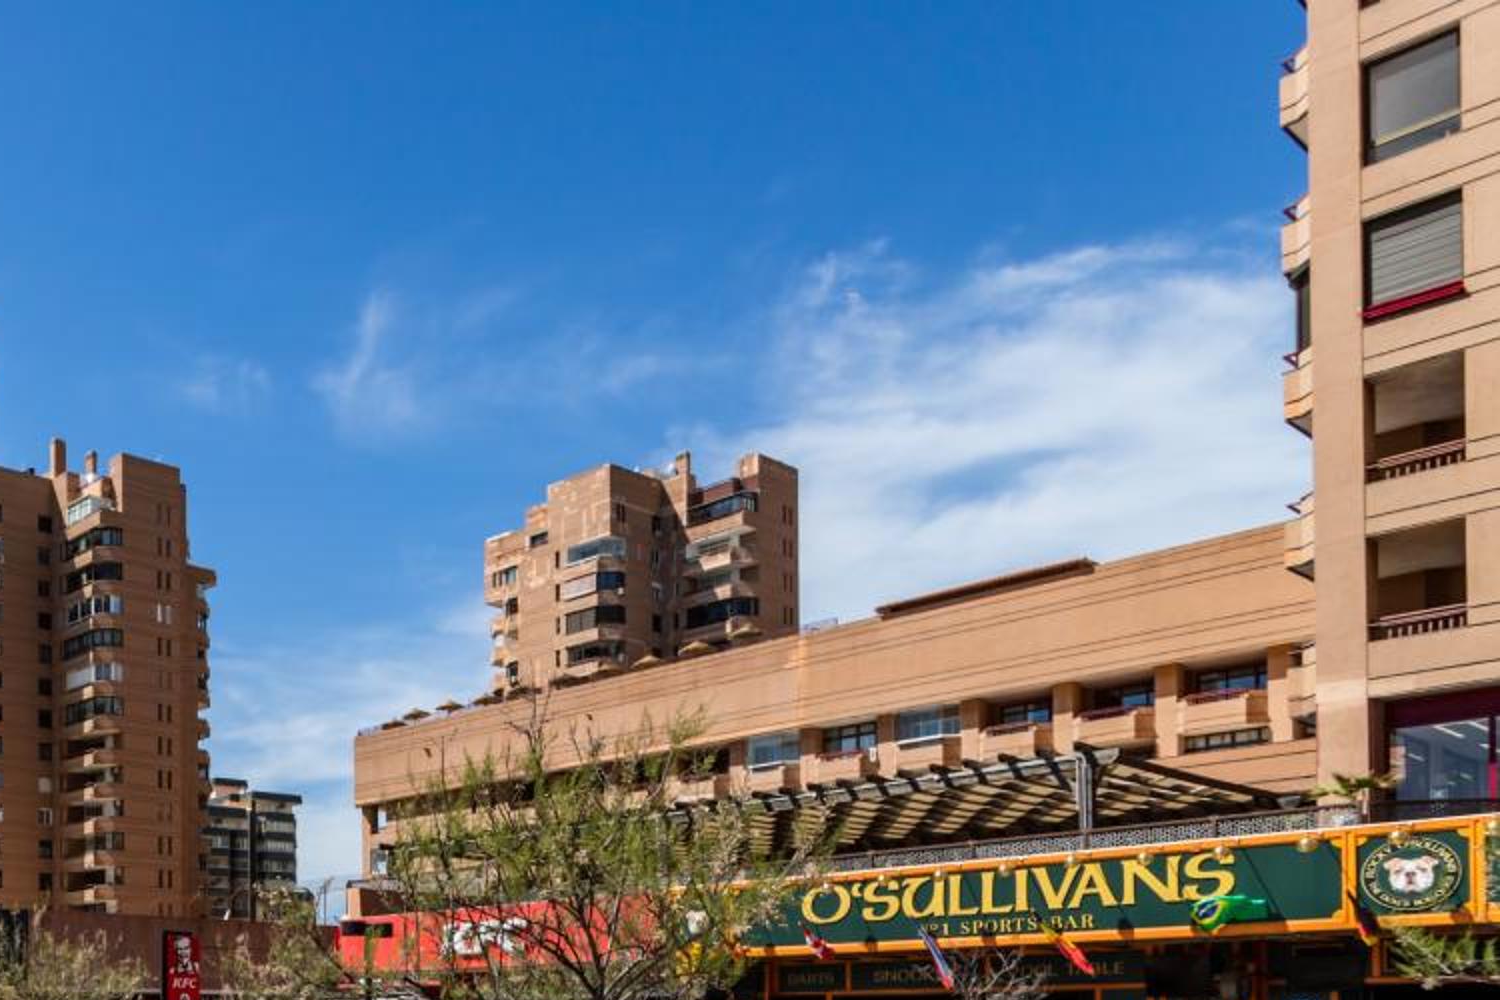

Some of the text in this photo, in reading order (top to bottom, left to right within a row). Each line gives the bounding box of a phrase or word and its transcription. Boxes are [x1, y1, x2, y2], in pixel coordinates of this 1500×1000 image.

[801, 852, 1236, 924] O'SULLIVANS
[961, 917, 1038, 935] SPORTS
[1052, 913, 1094, 930] BAR
[1068, 959, 1125, 977] TBLE
[172, 977, 197, 989] KFC
